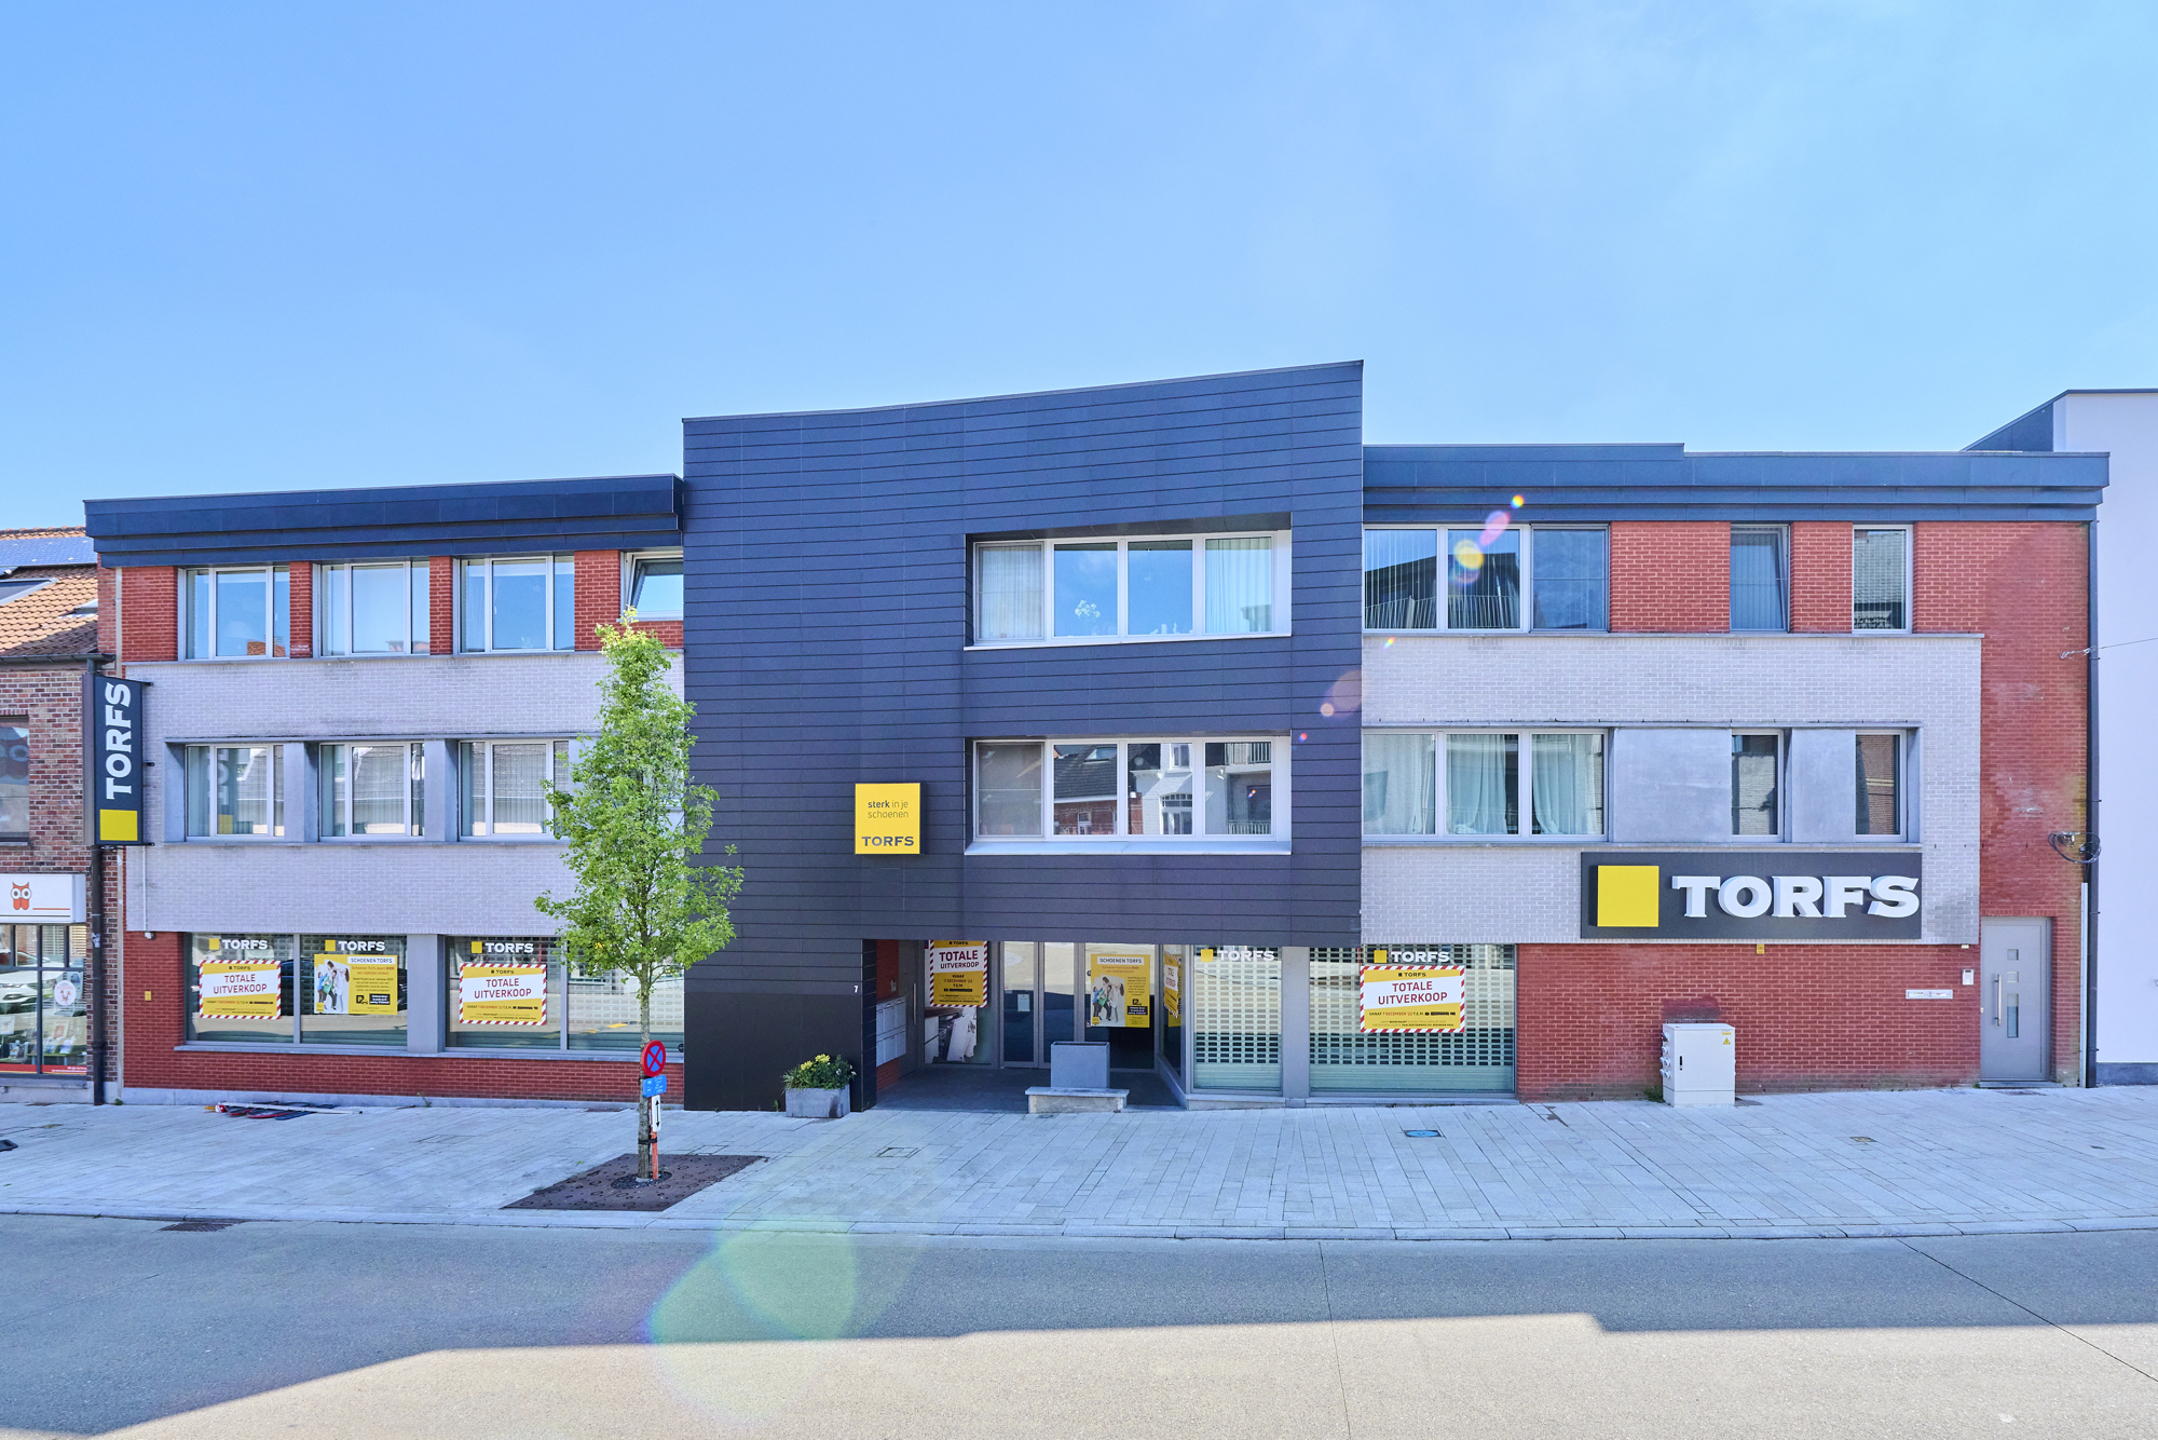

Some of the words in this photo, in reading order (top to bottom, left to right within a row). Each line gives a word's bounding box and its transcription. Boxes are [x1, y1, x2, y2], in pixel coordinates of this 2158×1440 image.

[105, 682, 132, 799] TORFS
[868, 800, 890, 809] sterk
[892, 800, 899, 808] in
[901, 800, 909, 810] je
[868, 810, 909, 818] schoenen
[861, 836, 914, 846] TORFS
[1672, 875, 1920, 918] TORFS
[222, 939, 268, 950] TORFS
[338, 940, 385, 951] TORFS
[485, 942, 534, 953] TORFS
[939, 950, 978, 961] TOTALE
[1217, 950, 1275, 961] TORFS
[1391, 951, 1450, 962] TORFS
[224, 974, 256, 983] TOTALE
[486, 978, 519, 987] TOTALE
[213, 983, 267, 994] UITVERKOOP
[1392, 981, 1433, 992] TOTALE
[474, 988, 532, 999] UITVERKOOP
[1378, 992, 1448, 1005] UITVERKOOP
